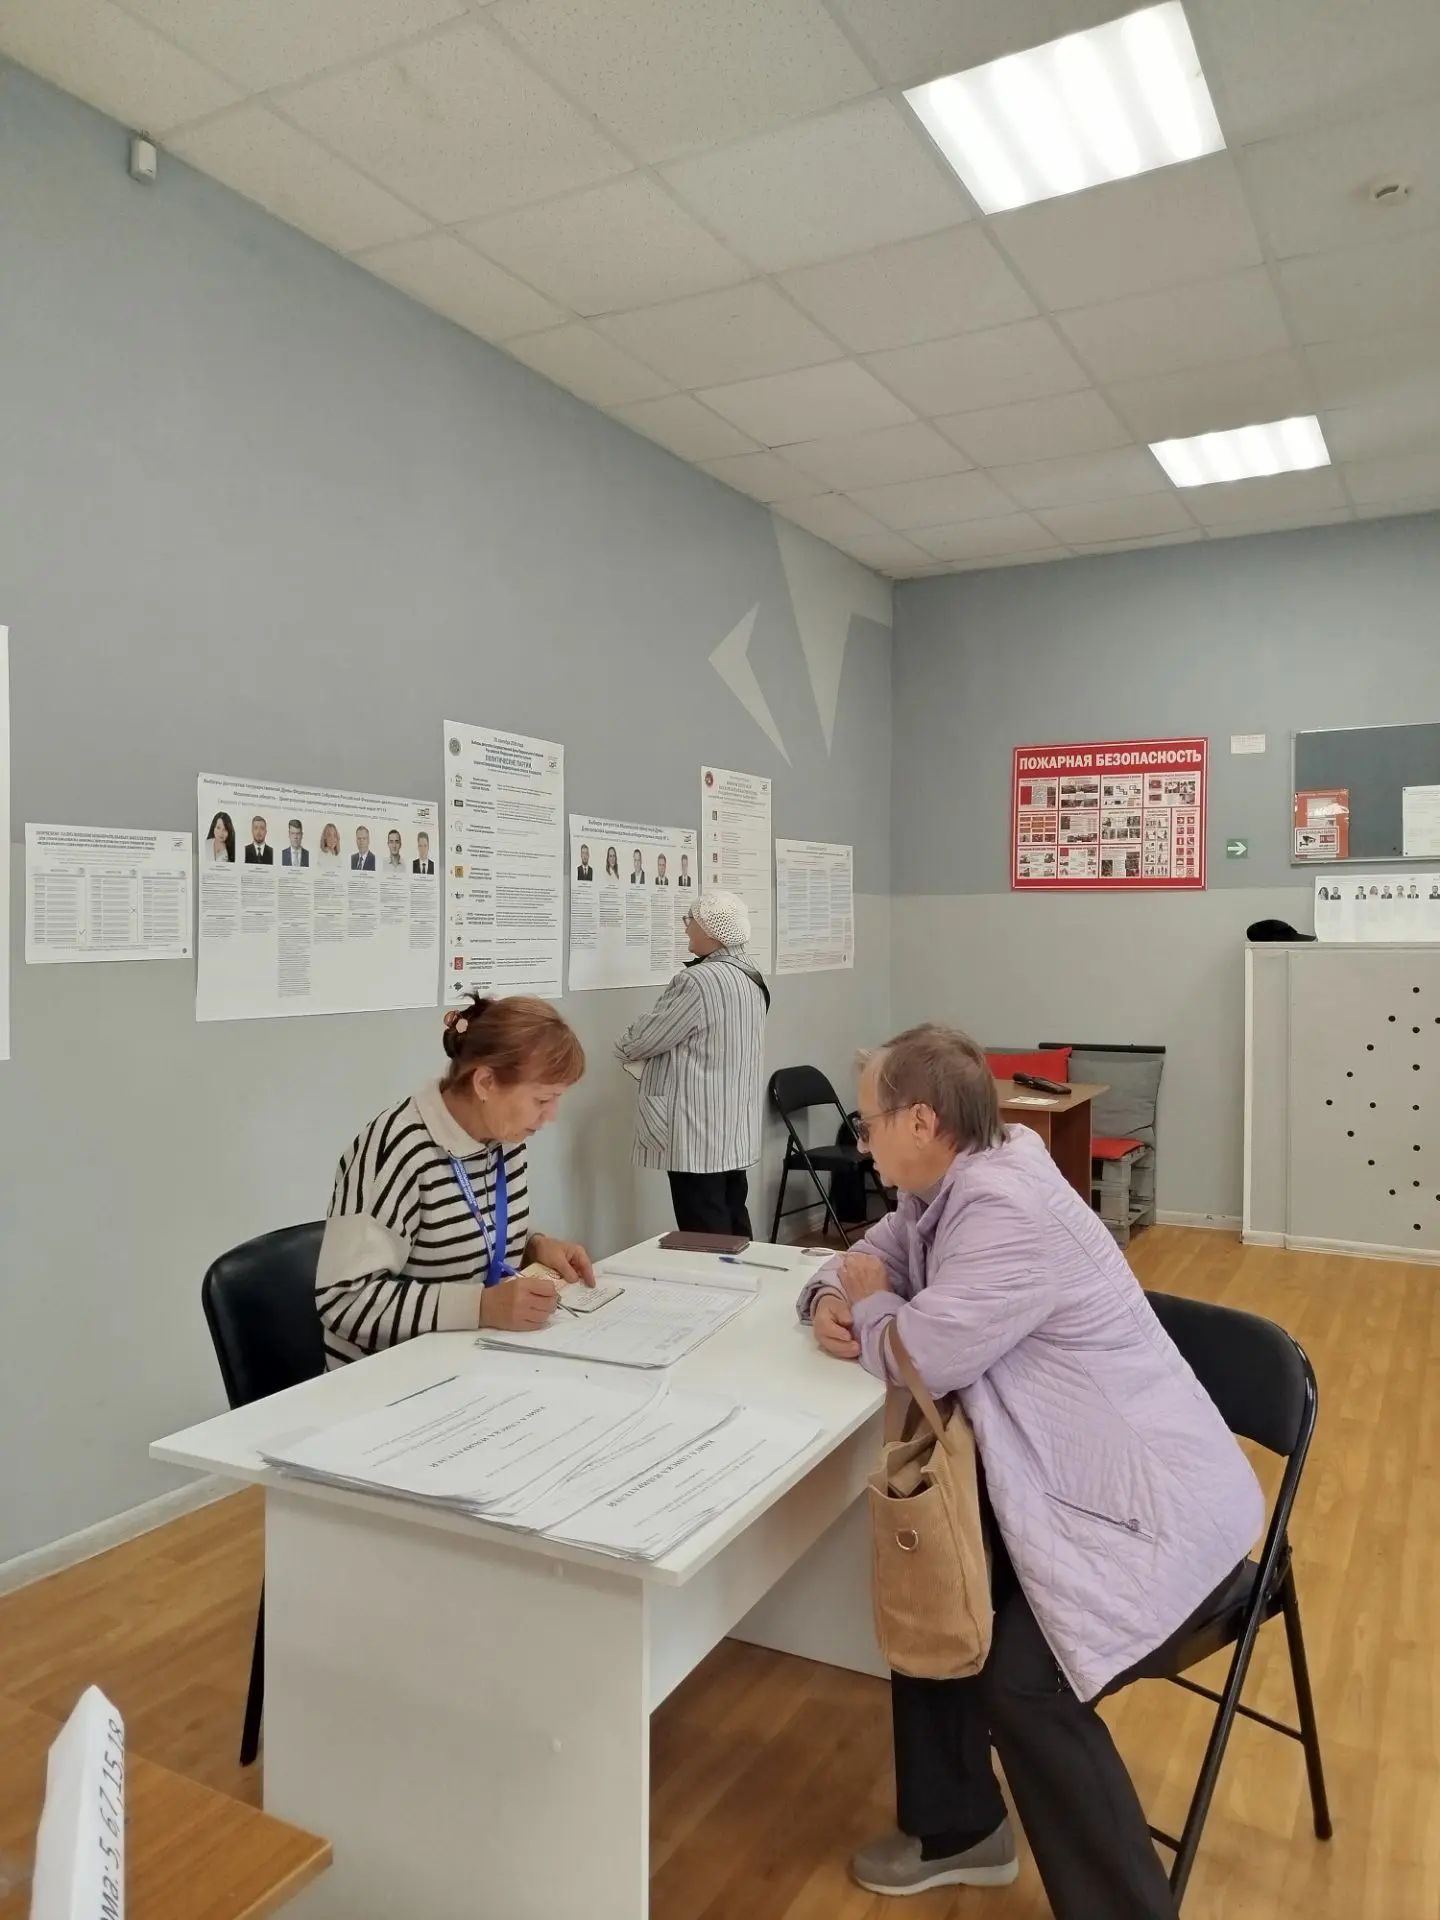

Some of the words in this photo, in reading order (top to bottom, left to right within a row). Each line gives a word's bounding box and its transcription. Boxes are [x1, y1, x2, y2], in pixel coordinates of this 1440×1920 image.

[1019, 756, 1093, 770] ПОЖАРНАЯ
[1096, 750, 1202, 766] БЕЗОПАСНОСТЬ
[100, 1865, 119, 1920] ма:
